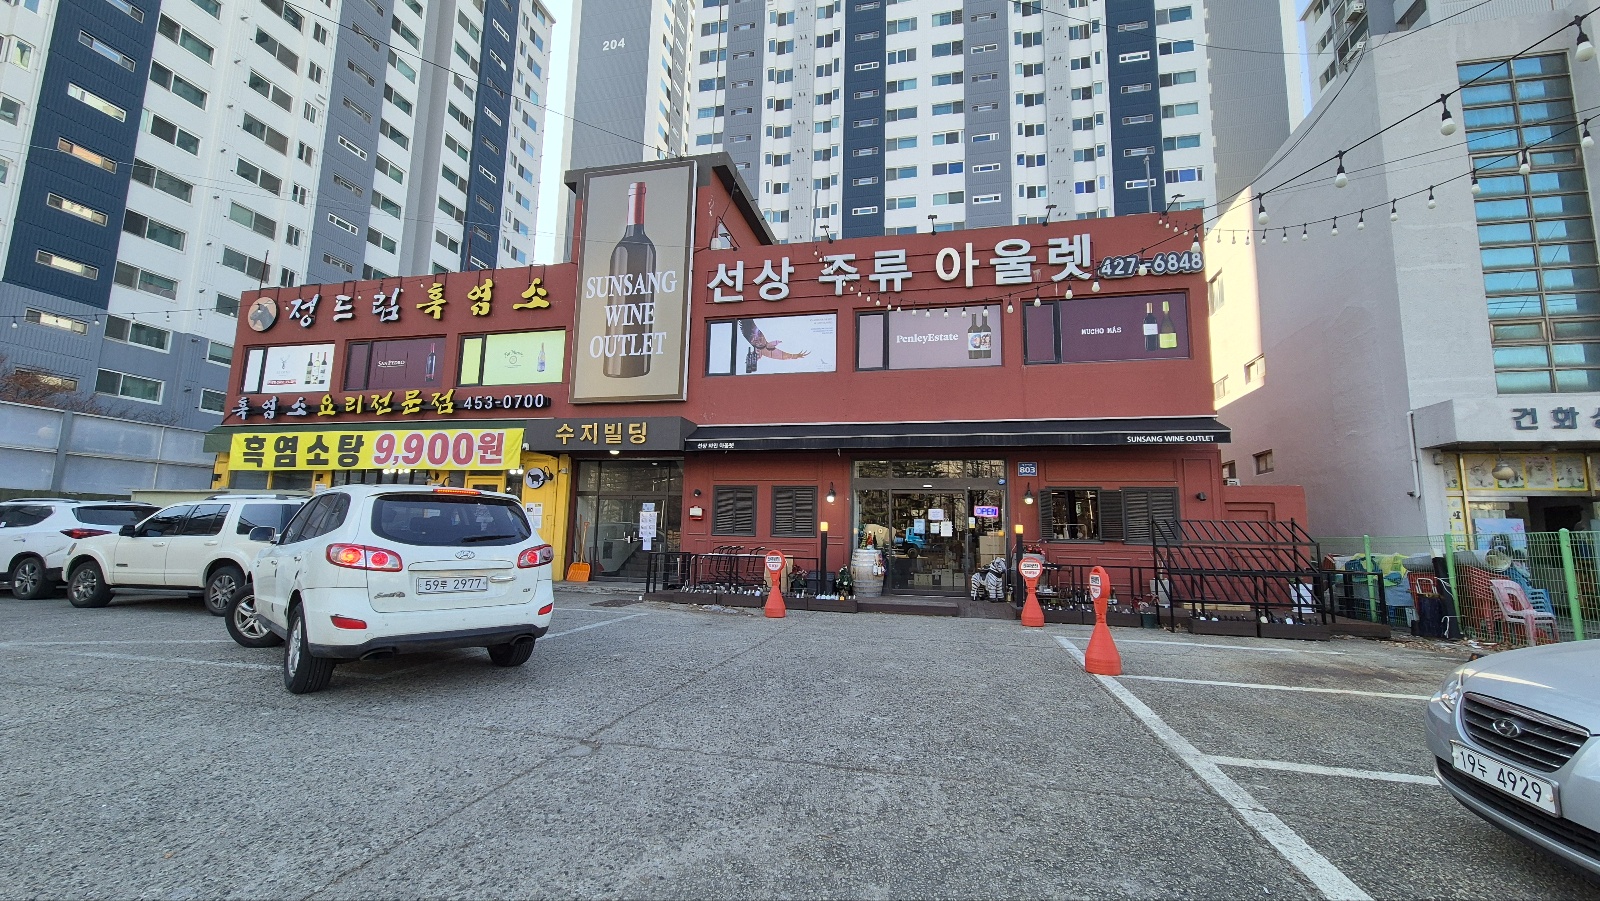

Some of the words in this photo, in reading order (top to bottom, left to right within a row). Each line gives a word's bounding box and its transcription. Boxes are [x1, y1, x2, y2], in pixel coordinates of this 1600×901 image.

[602, 37, 626, 51] 204
[707, 256, 795, 303] 선상
[818, 248, 913, 297] 주류
[935, 233, 1092, 288] 아울렛
[1101, 251, 1203, 276] 427-6848
[585, 270, 678, 299] SUNSANG
[416, 277, 550, 320] 흑염소
[604, 302, 656, 327] WINE
[1081, 327, 1105, 335] MUCHO
[589, 331, 667, 359] OUTLET
[231, 395, 308, 421] 흑염소
[463, 393, 545, 410] 453-0700
[555, 421, 648, 445] 수지빌딩
[1127, 435, 1163, 443] SUNSANG
[242, 434, 365, 468] 흑염소탕
[372, 431, 505, 466] 9,900원
[1019, 466, 1036, 474] 803
[975, 507, 997, 516] OPEN
[424, 579, 448, 591] 59루
[453, 578, 482, 590] 2977
[1460, 750, 1488, 778] 19누
[1497, 767, 1542, 803] 4929
